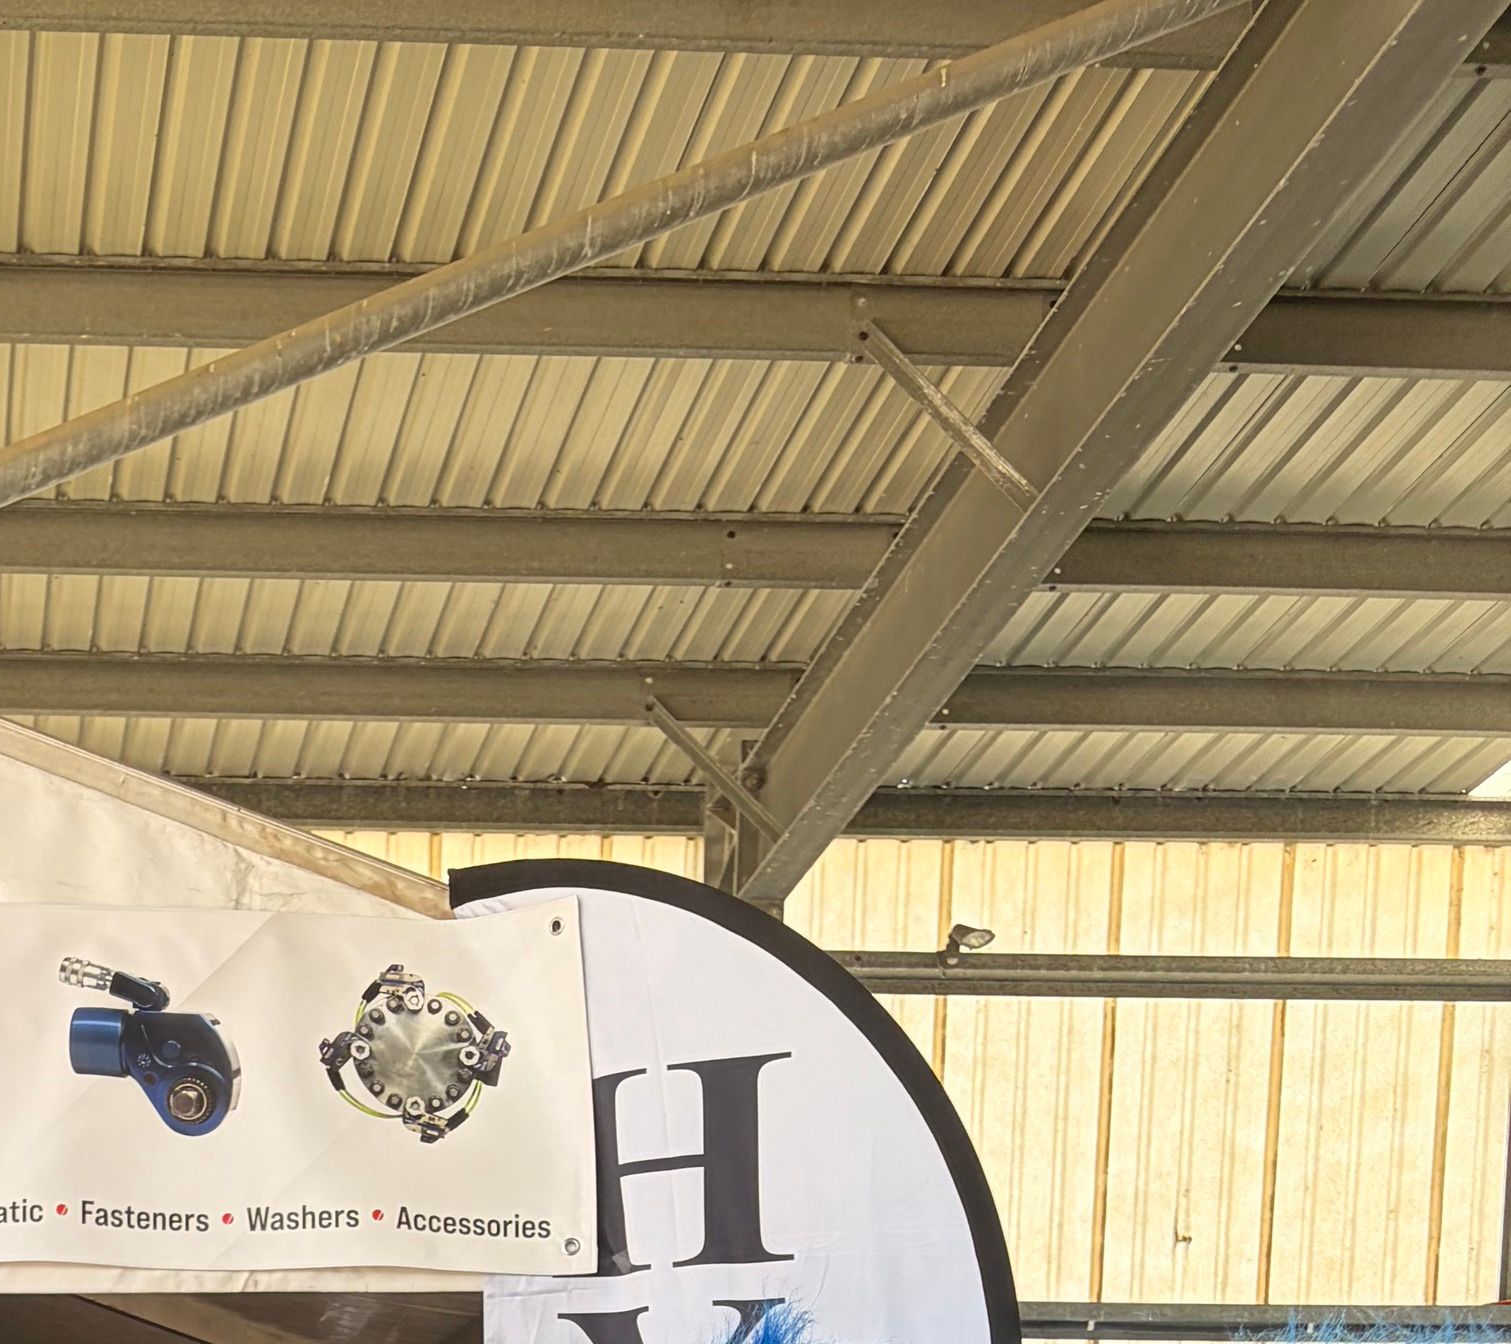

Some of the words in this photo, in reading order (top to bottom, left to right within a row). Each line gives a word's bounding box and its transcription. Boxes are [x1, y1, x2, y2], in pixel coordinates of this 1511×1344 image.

[81, 1200, 210, 1233] Fasteners
[247, 1205, 359, 1232] Washers
[396, 1206, 552, 1240] Accessories
